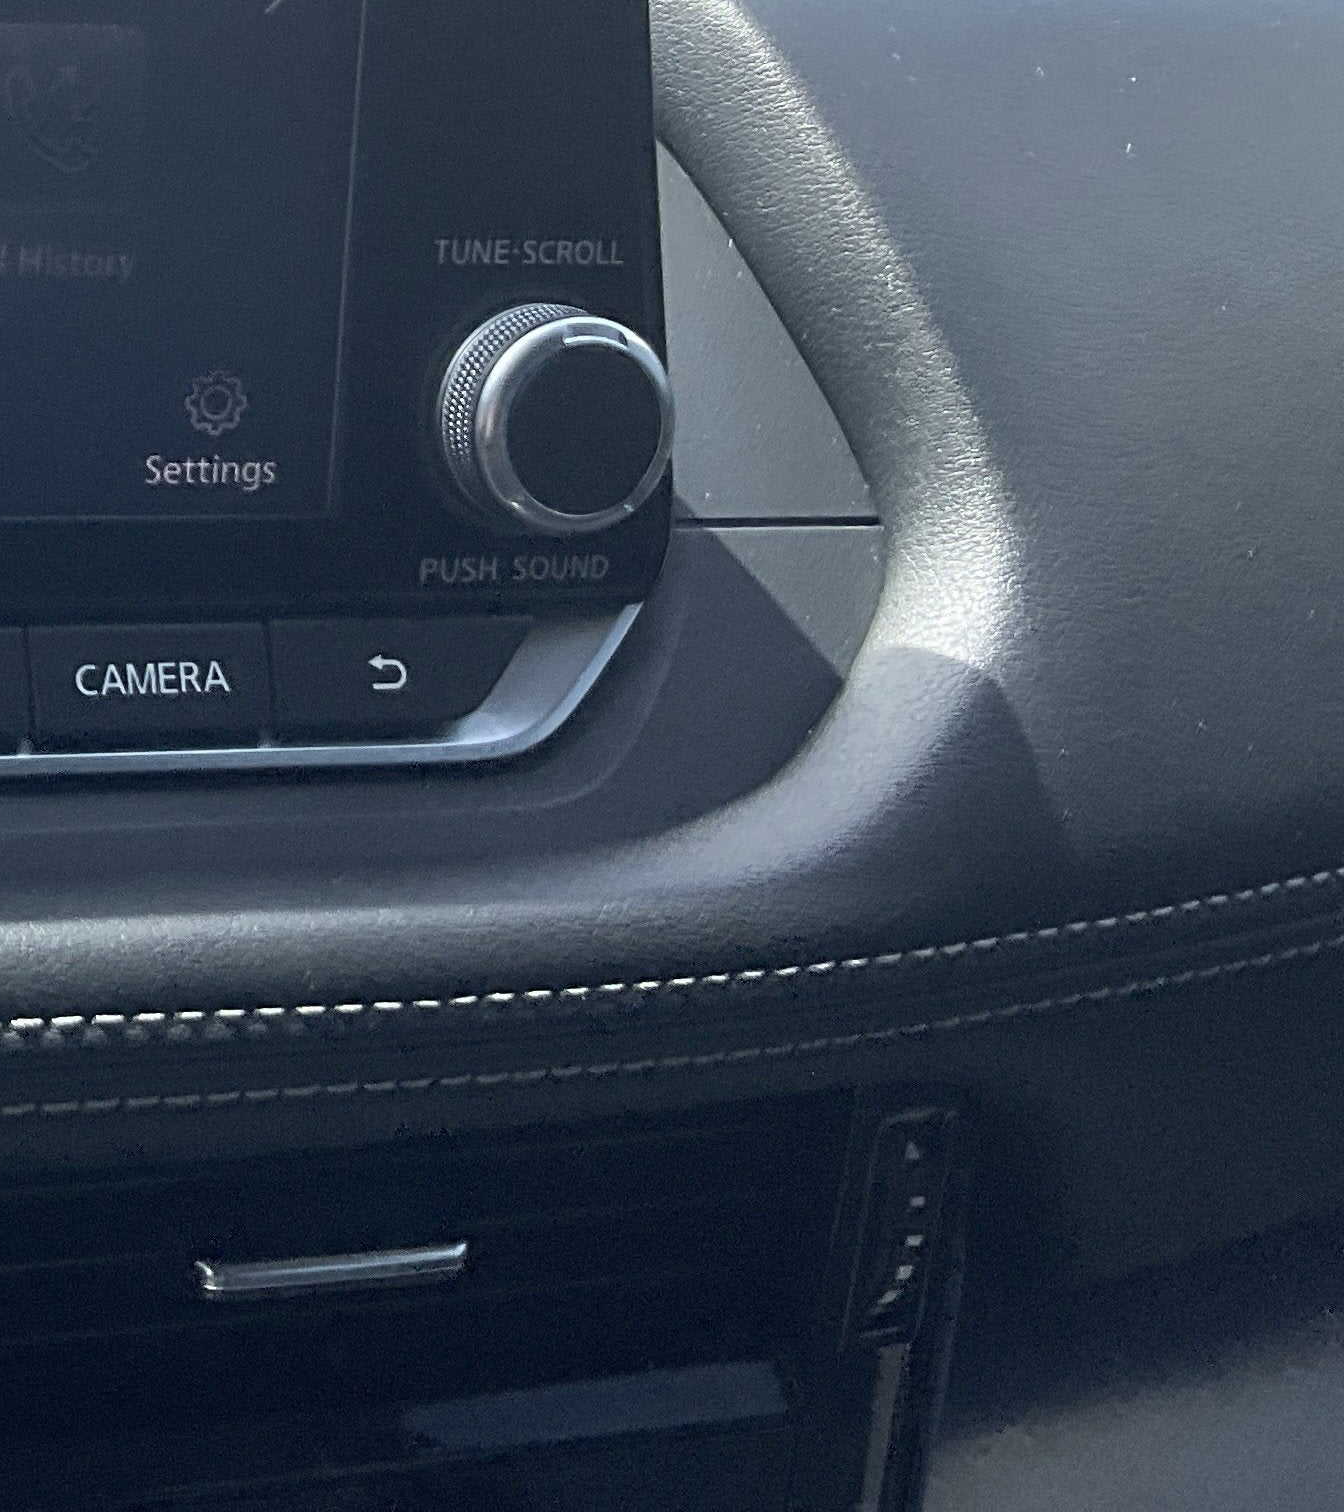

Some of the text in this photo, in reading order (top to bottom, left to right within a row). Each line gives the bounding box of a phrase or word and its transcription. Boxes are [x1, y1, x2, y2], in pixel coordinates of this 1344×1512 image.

[145, 454, 278, 492] Settings
[420, 553, 610, 583] PUSH SOUND
[74, 660, 230, 698] CAMERA
